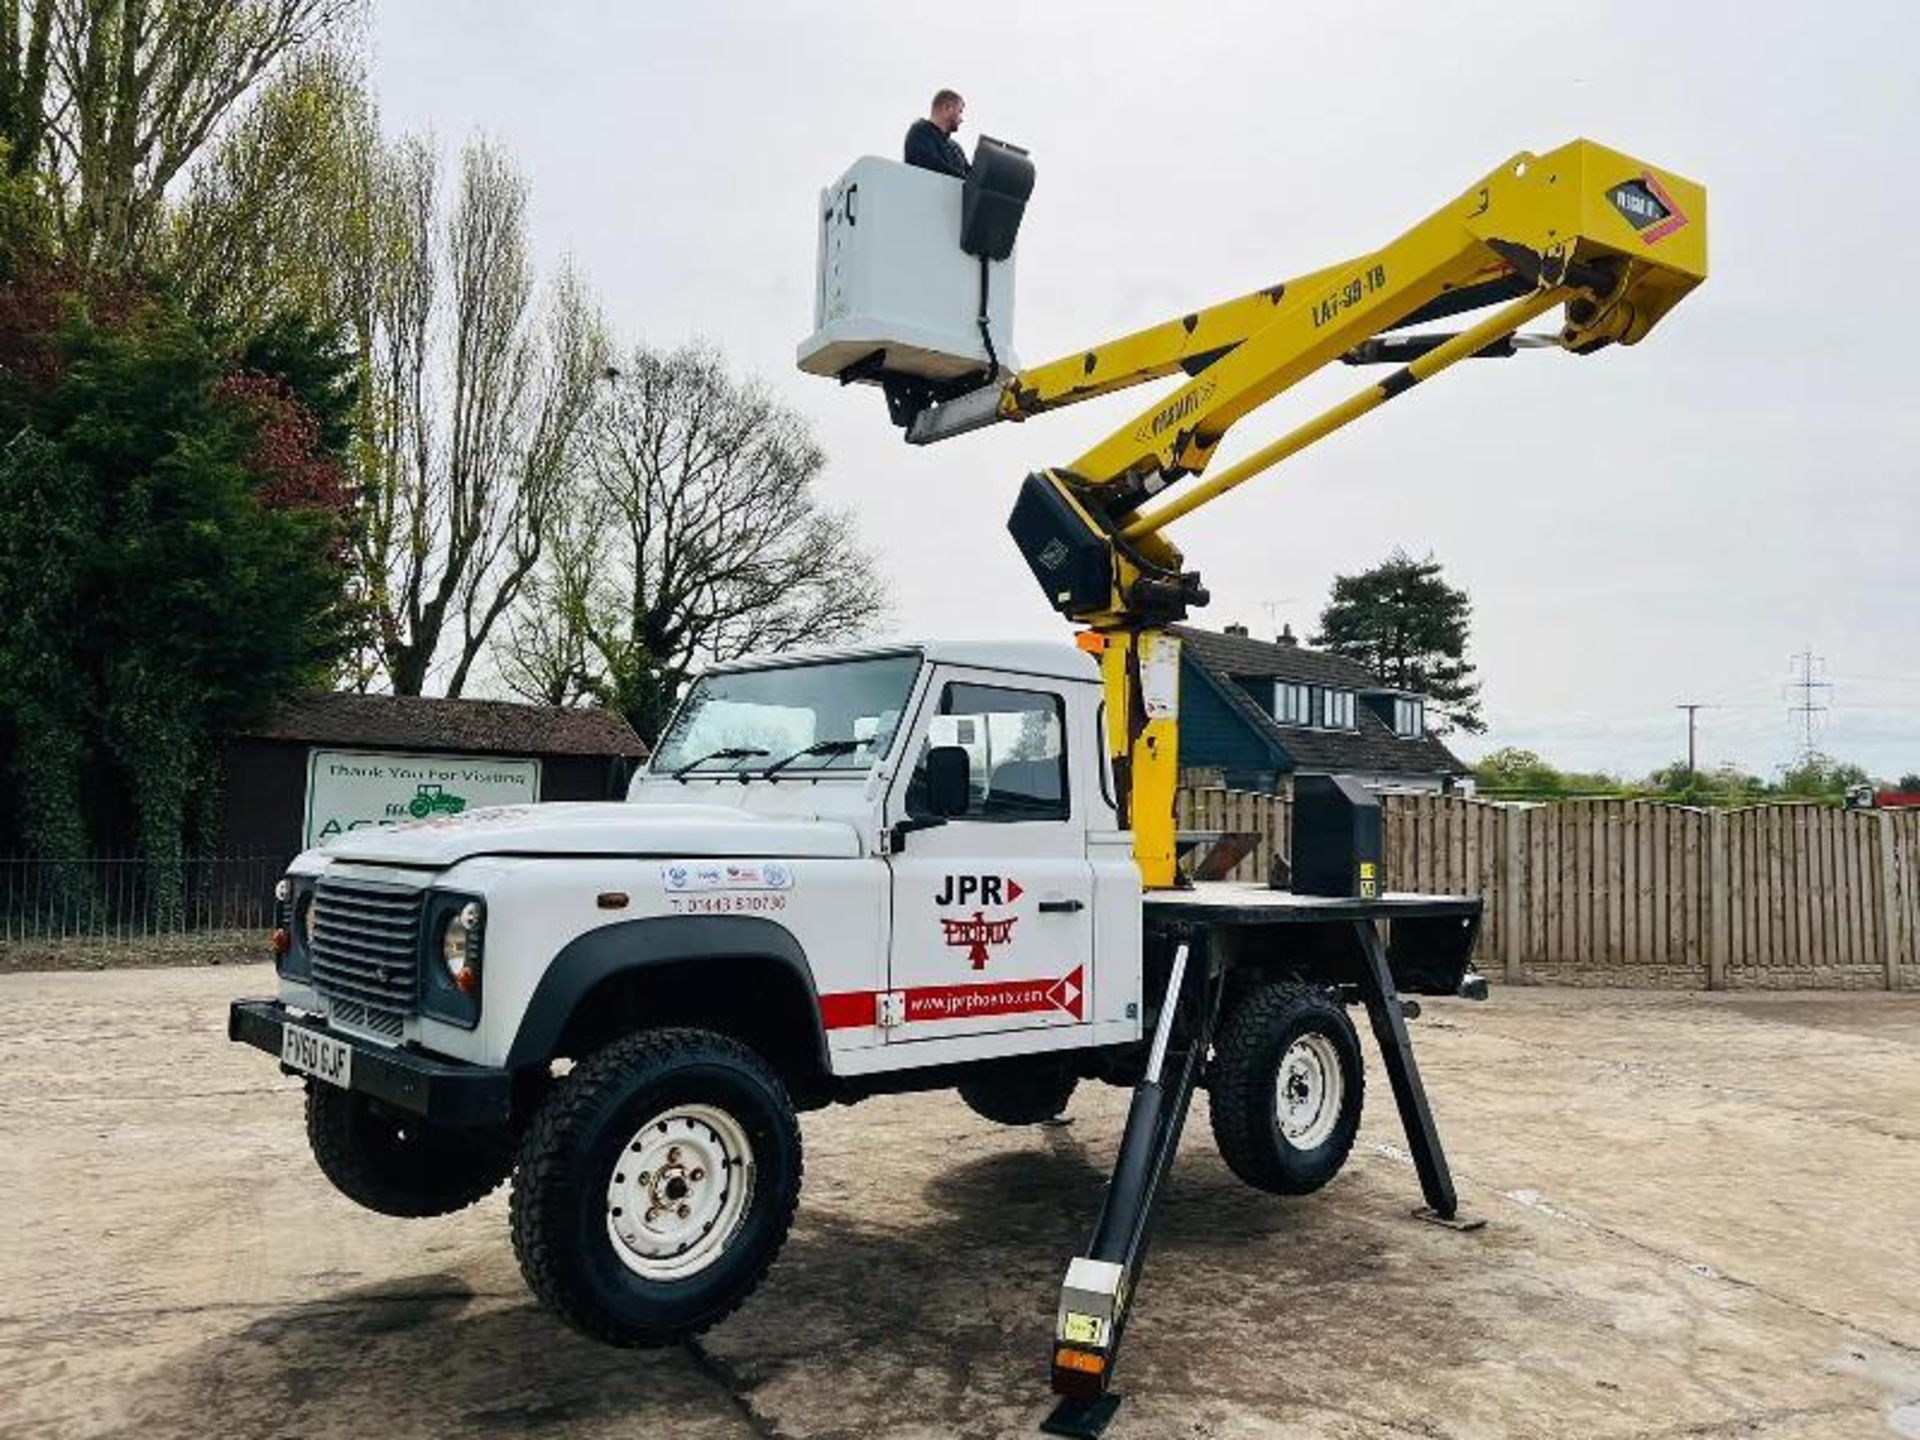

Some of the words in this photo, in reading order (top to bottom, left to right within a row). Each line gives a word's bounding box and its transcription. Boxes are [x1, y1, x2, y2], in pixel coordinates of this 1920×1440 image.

[330, 764, 383, 778] Thank
[389, 767, 424, 779] You
[429, 768, 457, 781] For
[463, 769, 526, 785] Visiting
[935, 875, 1004, 905] JPR
